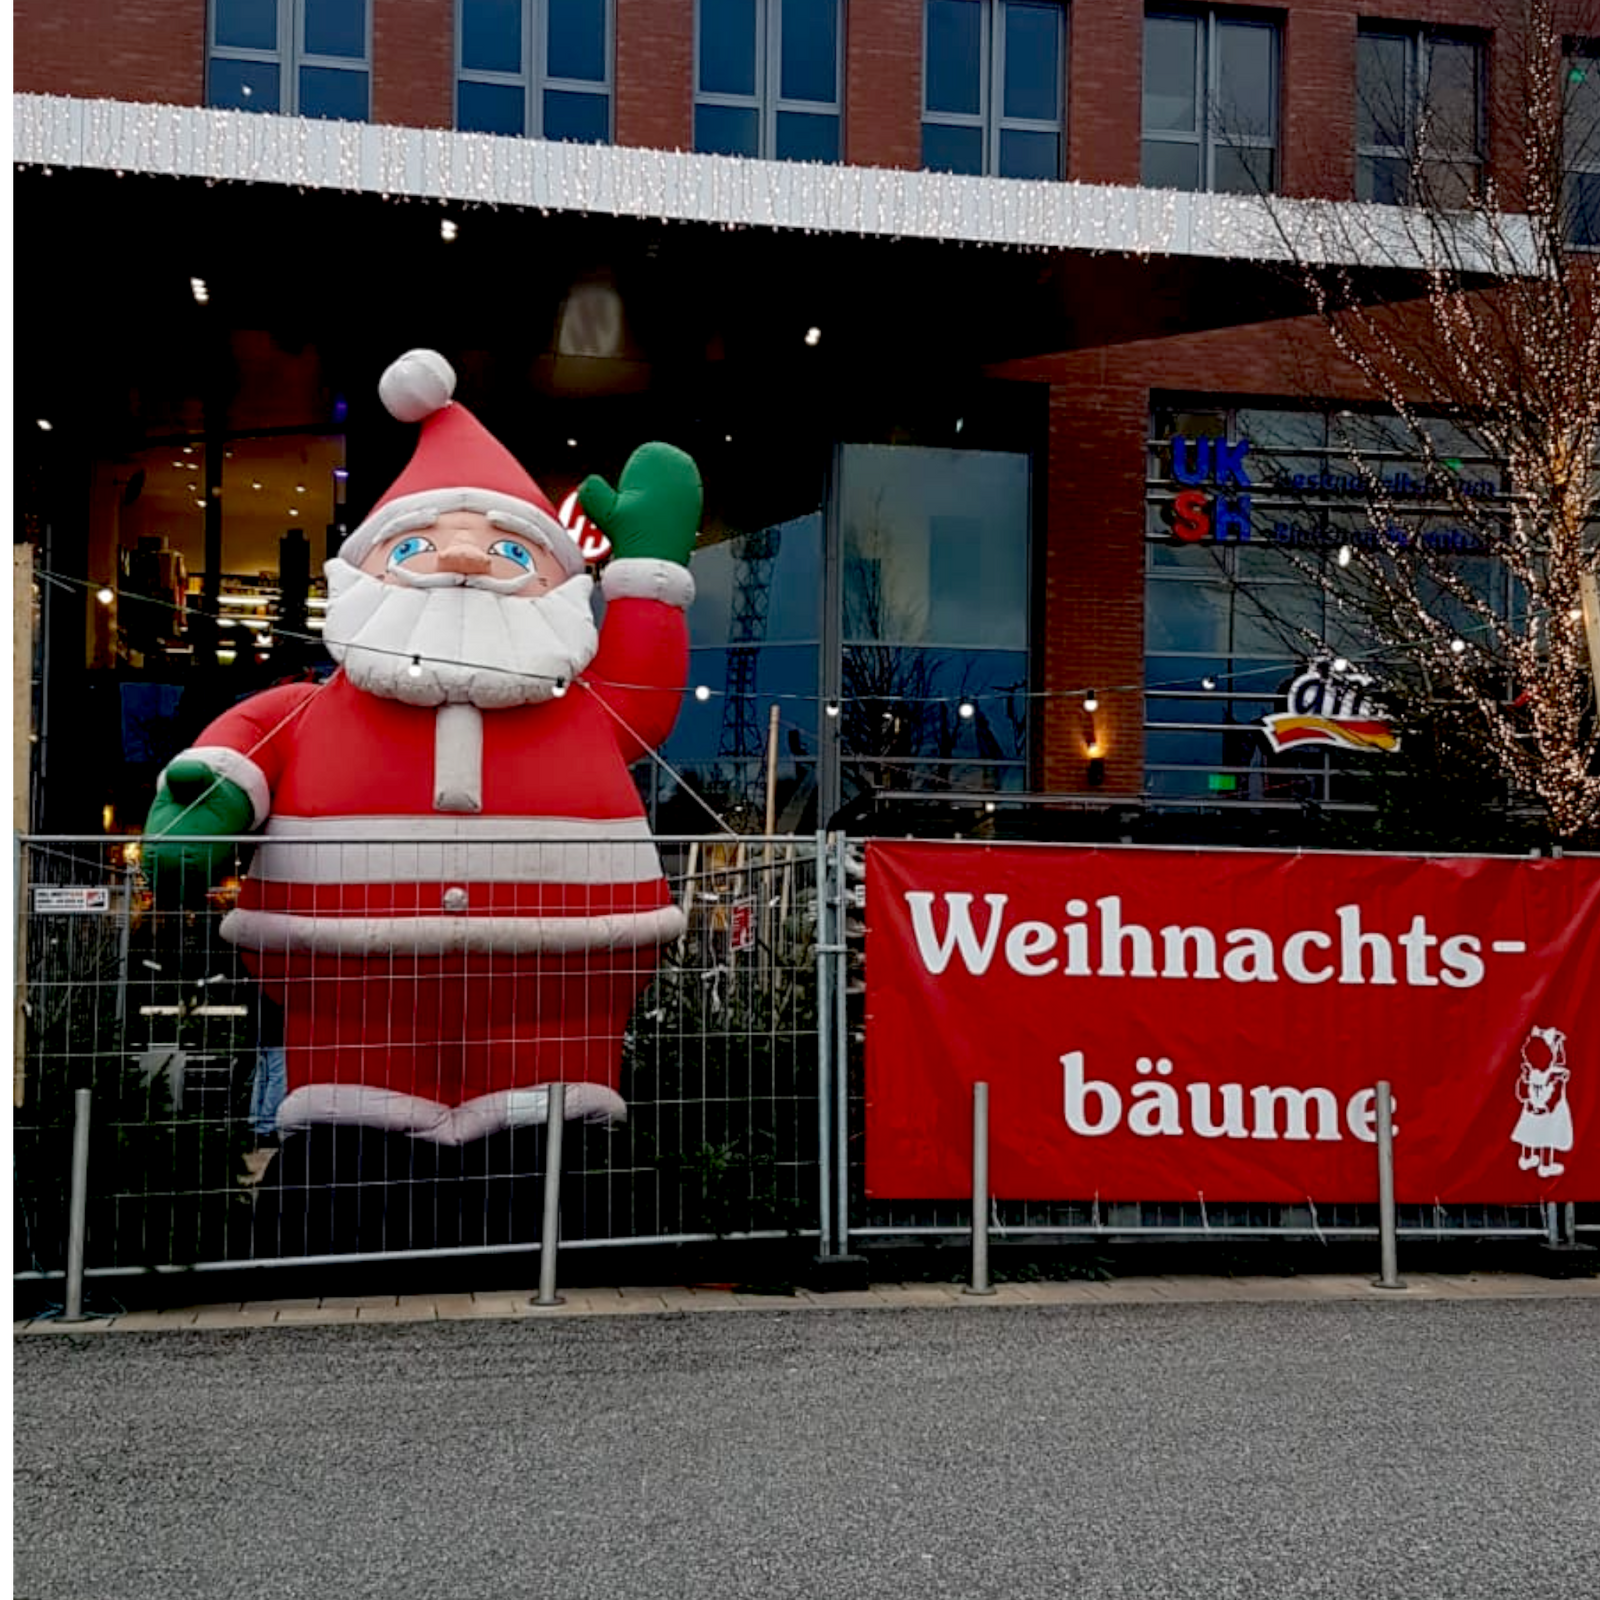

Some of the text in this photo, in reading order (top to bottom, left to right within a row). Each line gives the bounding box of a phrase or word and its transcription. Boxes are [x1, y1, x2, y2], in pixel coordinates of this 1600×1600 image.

[1170, 434, 1251, 487] UK
[1170, 488, 1251, 542] SH
[904, 890, 1527, 989] Weihnachts-
[1059, 1050, 1400, 1144] bäume
